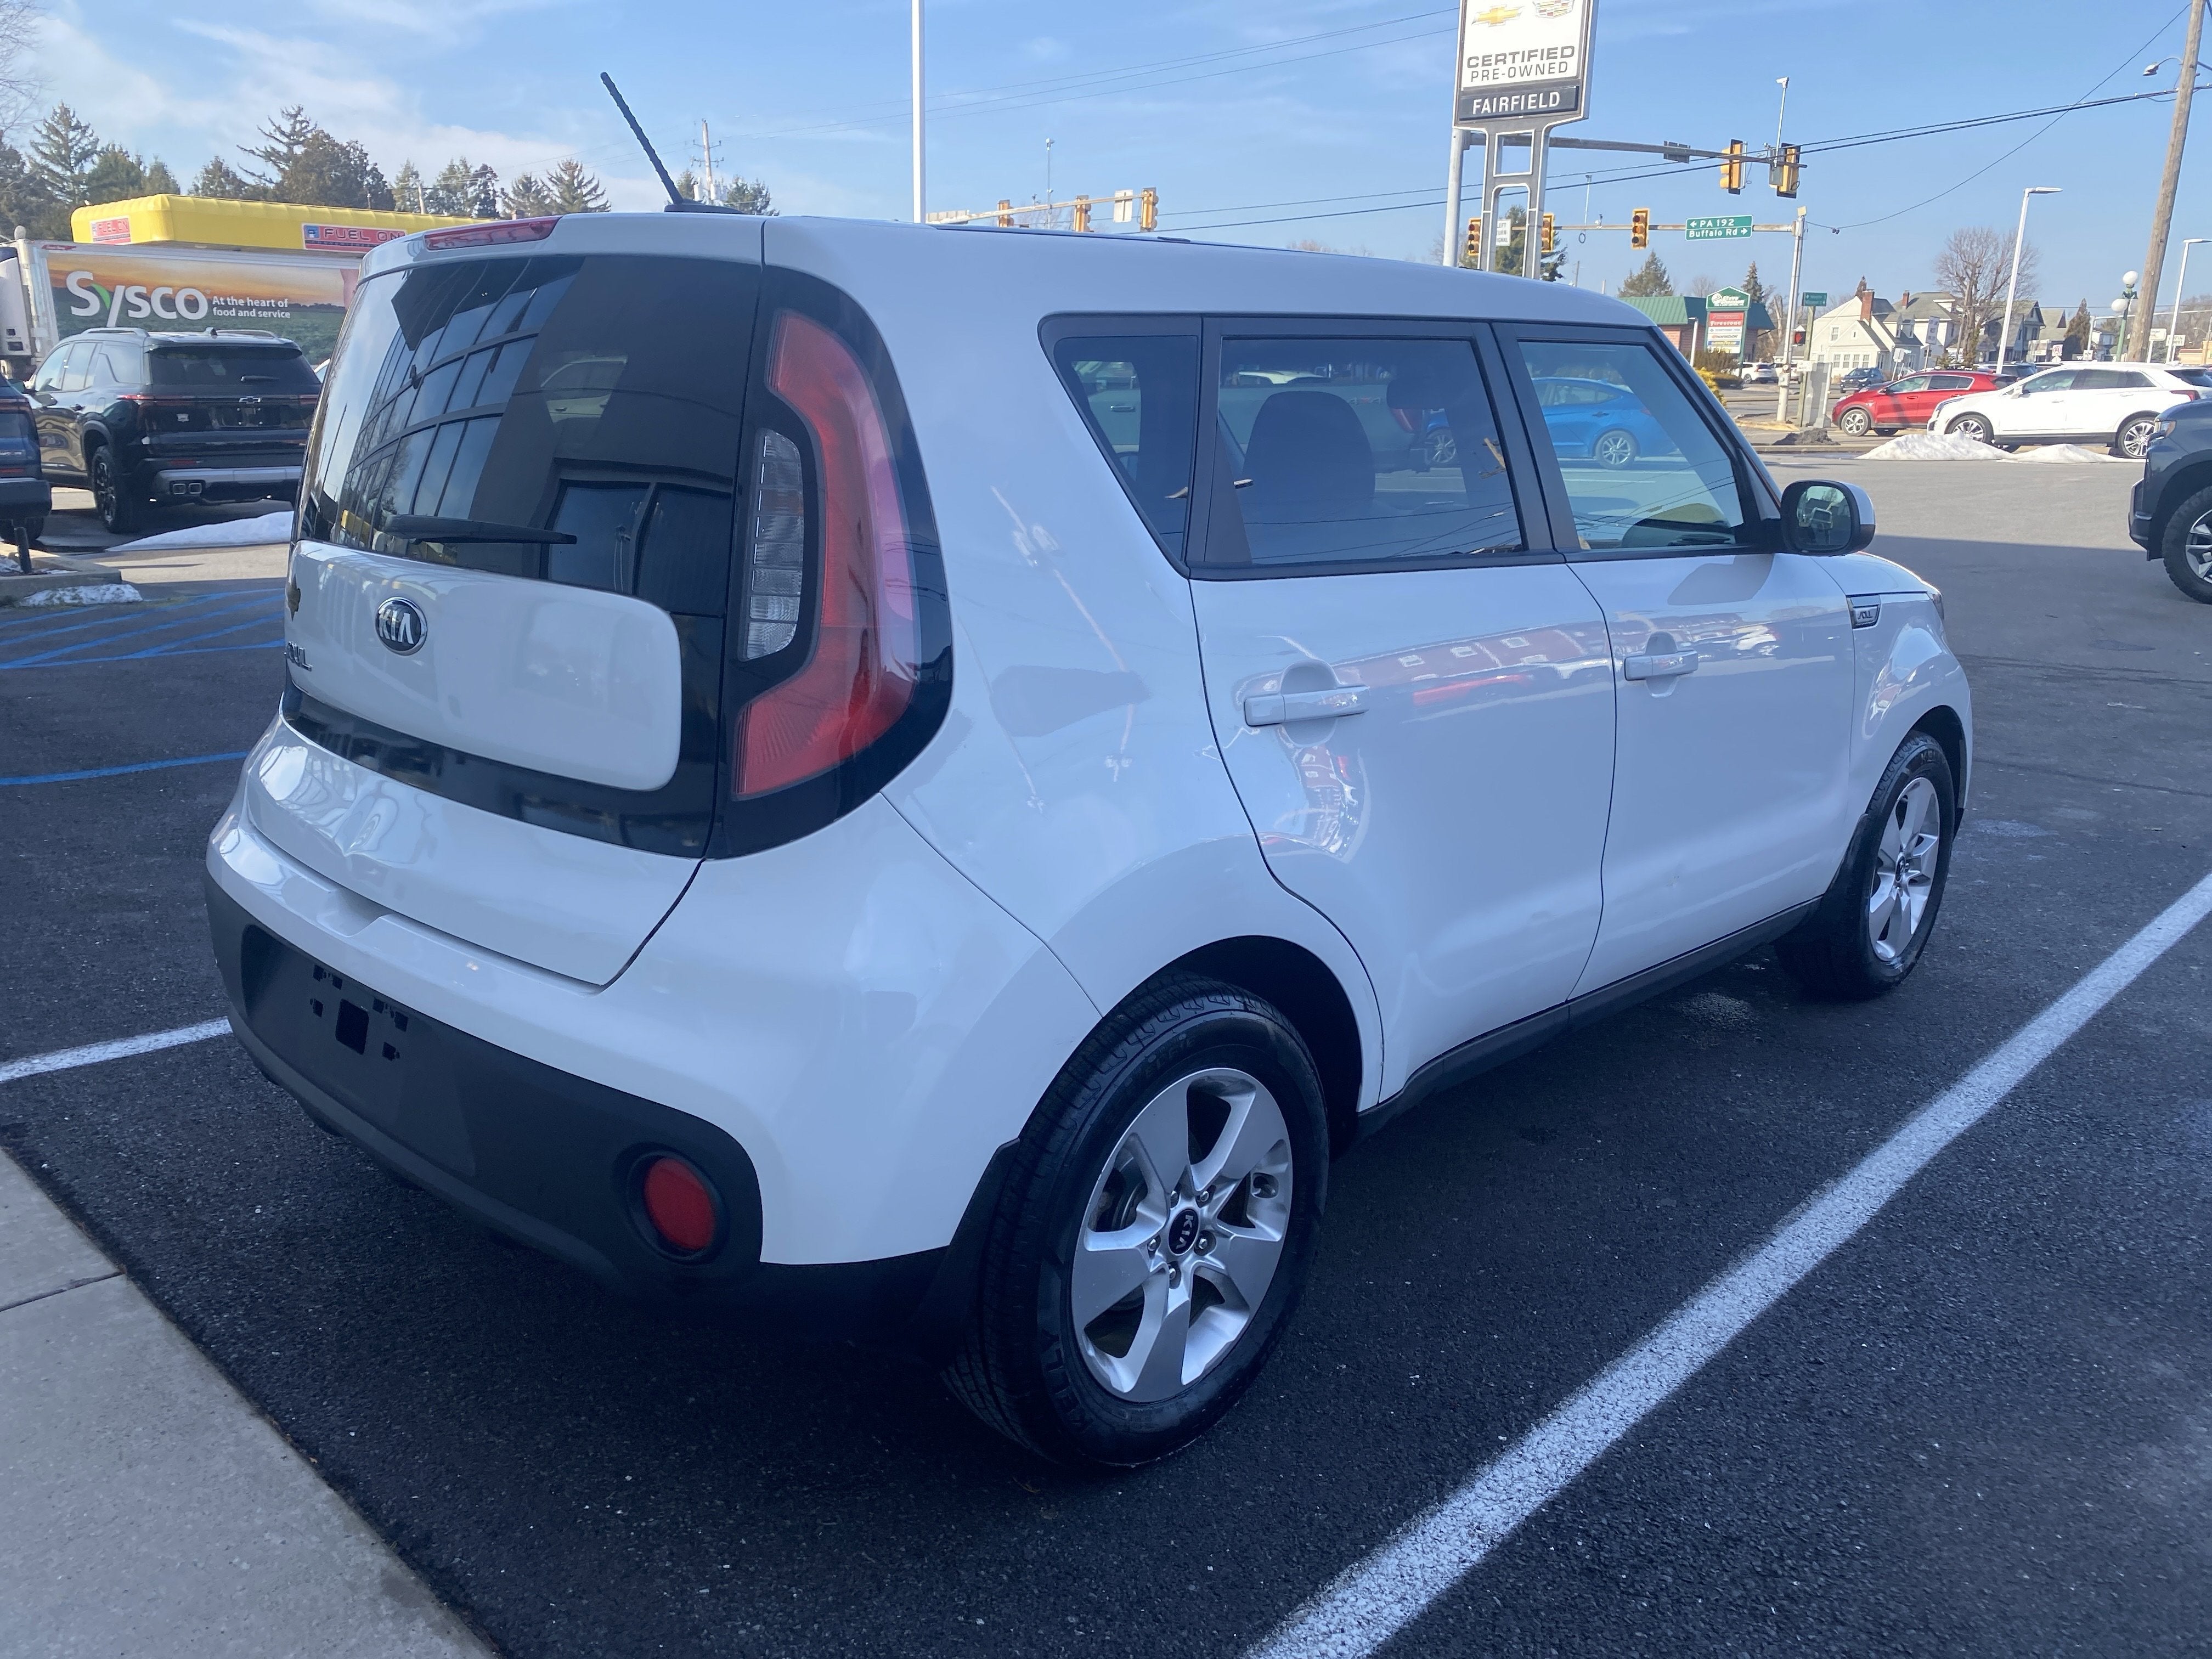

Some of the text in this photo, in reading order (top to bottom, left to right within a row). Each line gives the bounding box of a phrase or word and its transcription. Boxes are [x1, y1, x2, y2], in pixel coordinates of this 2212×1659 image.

[1467, 46, 1575, 69] CERTIFIED
[1471, 61, 1568, 82] PRE-OWNED
[1472, 91, 1560, 115] FAIRFIELD
[1717, 218, 1734, 227] 192
[324, 228, 370, 240] FUEL
[1689, 229, 1723, 238] Buffalo
[212, 296, 289, 308] At the heart of
[212, 307, 291, 318] food and service
[379, 608, 414, 645] KIA
[1176, 1215, 1194, 1249] KIA
